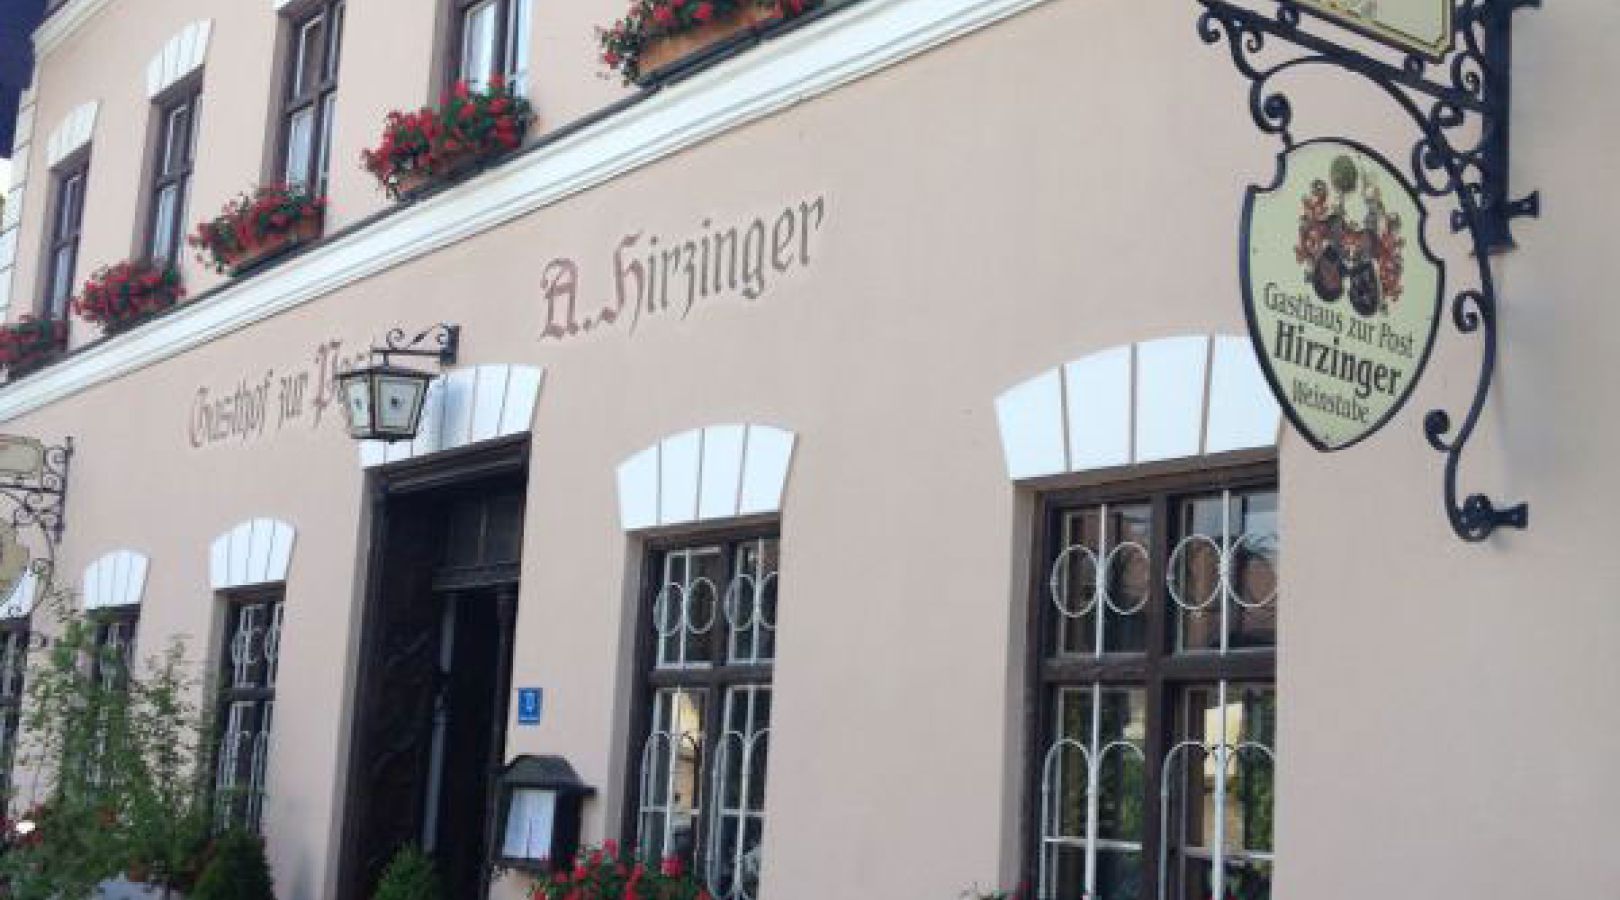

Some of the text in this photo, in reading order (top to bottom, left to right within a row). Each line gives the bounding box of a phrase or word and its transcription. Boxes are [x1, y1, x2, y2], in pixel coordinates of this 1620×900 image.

[597, 195, 825, 337] Hirzinger
[1263, 281, 1414, 359] Gasthaus zur Post
[1274, 319, 1403, 400] Hirzinger
